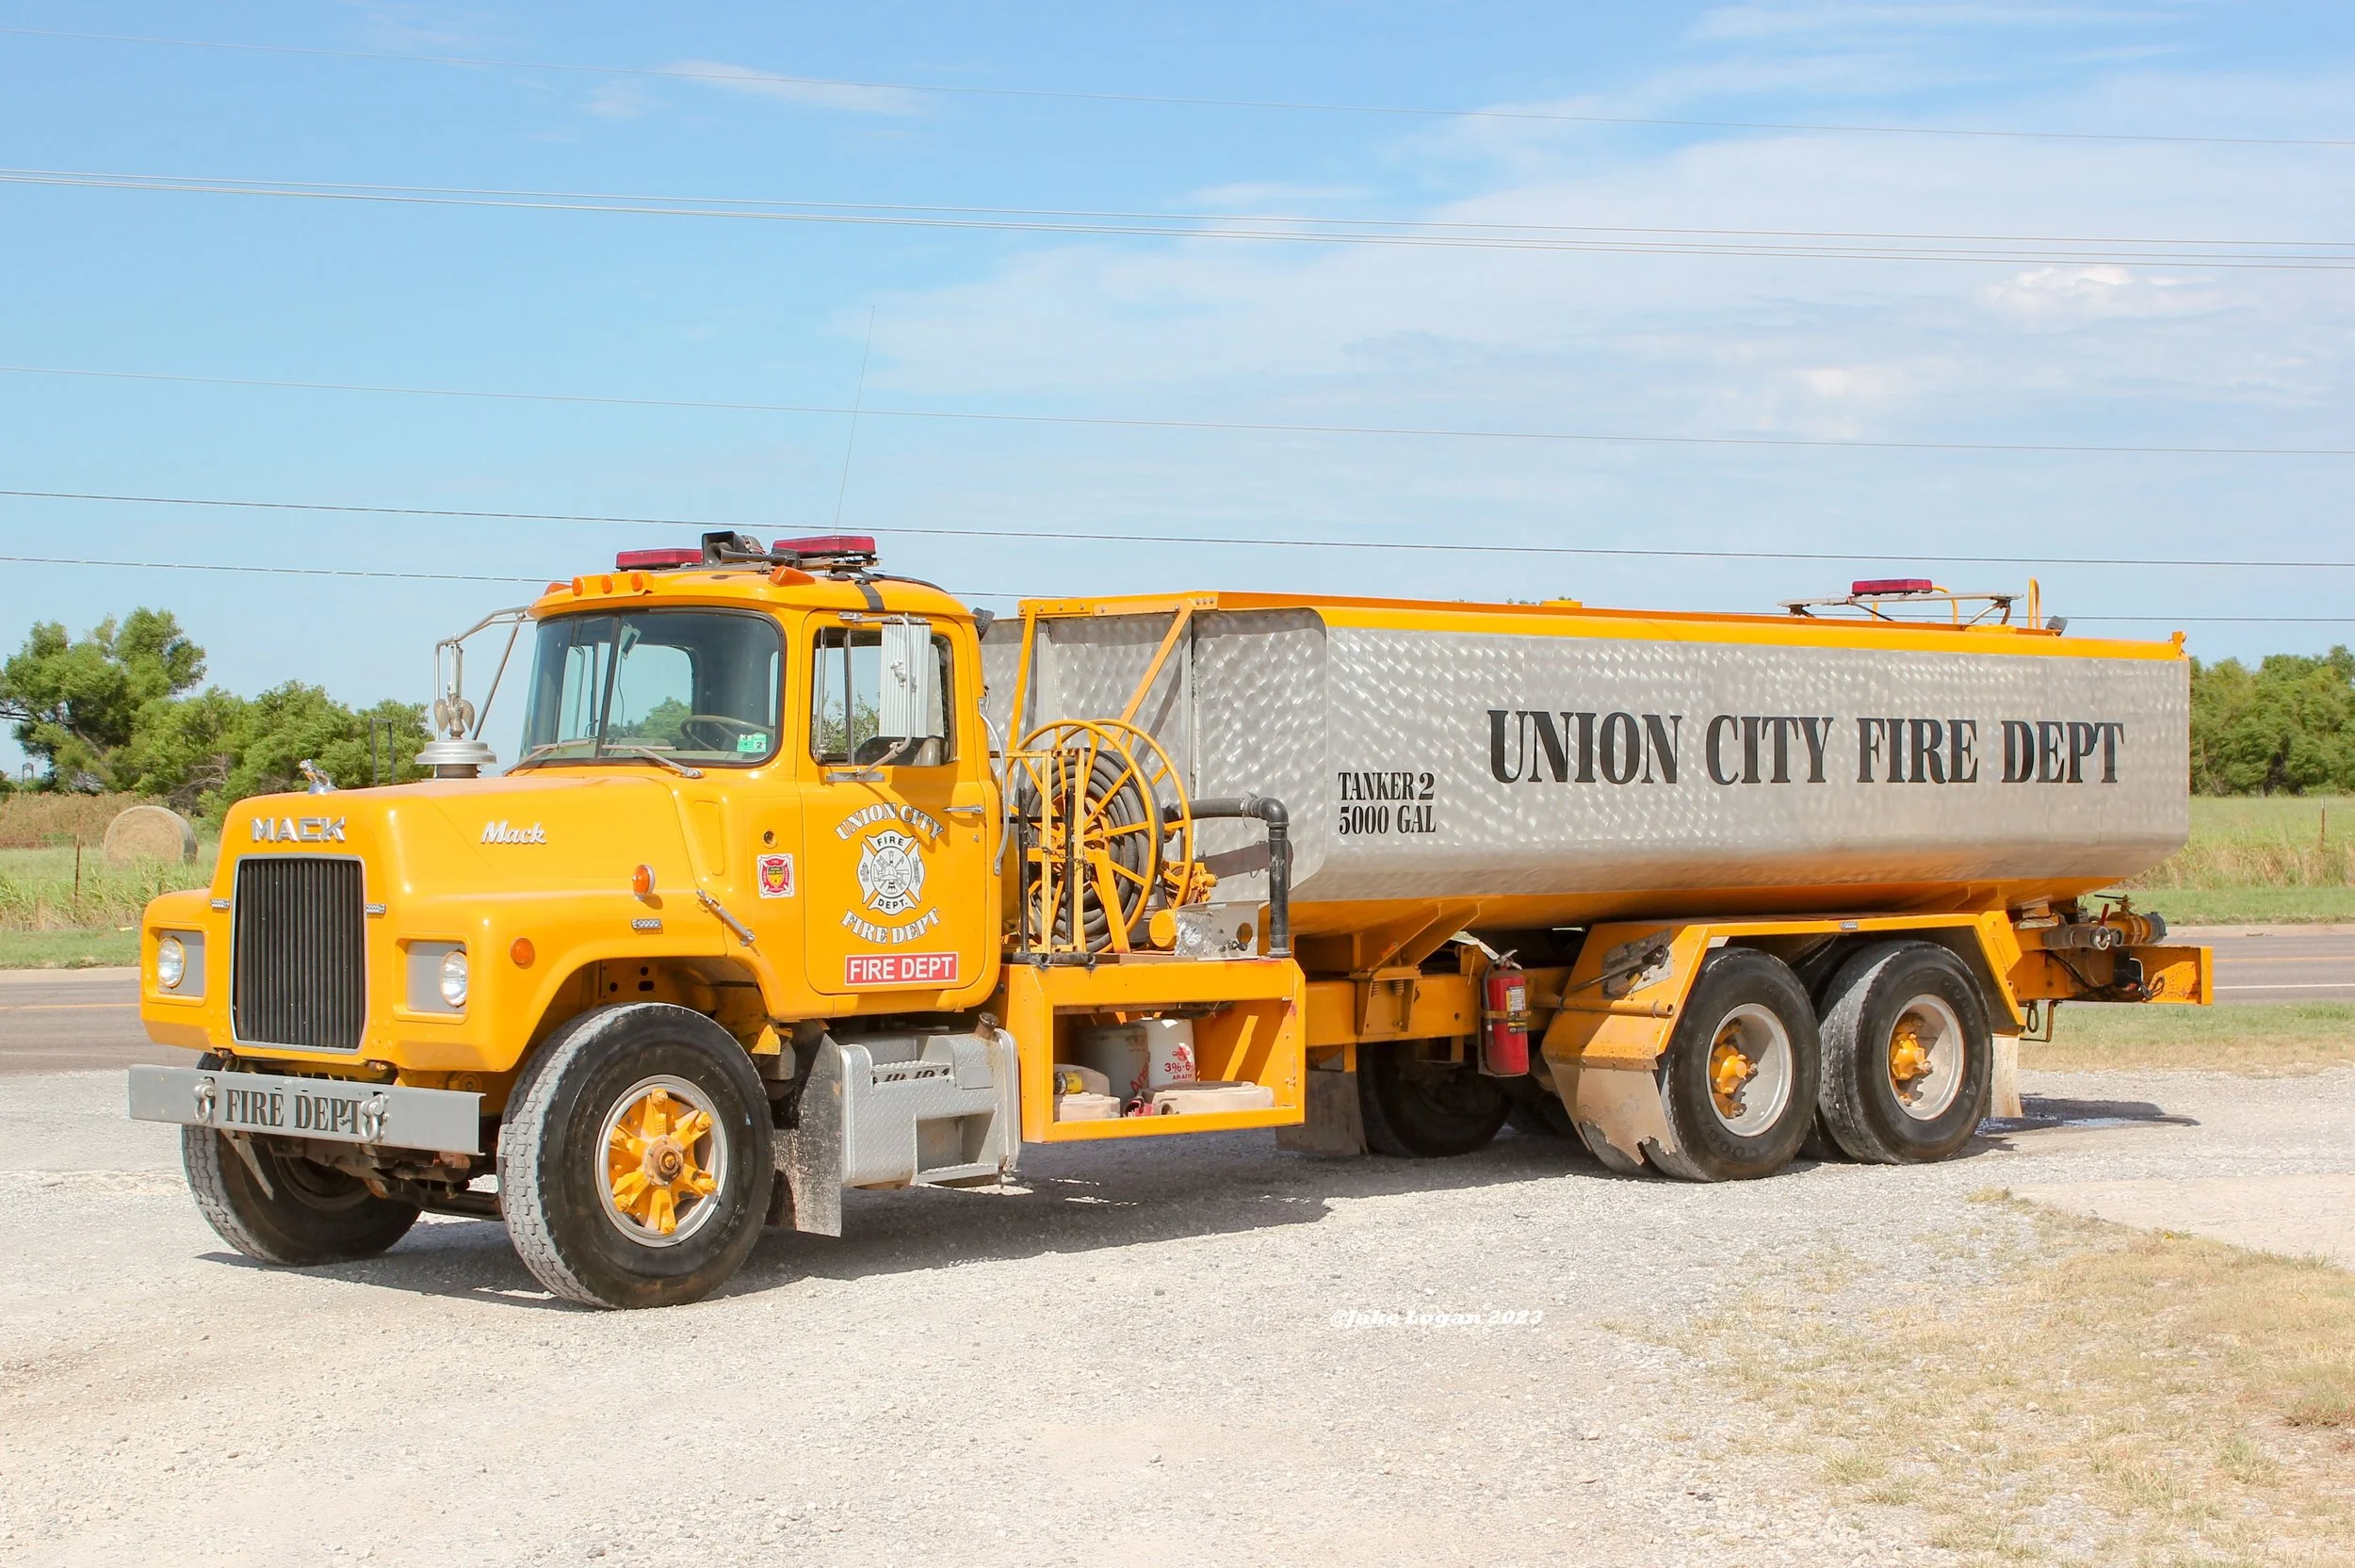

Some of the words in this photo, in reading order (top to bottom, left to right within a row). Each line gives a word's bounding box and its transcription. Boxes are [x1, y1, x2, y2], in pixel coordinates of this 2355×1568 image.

[1486, 709, 1682, 785] UNION
[1705, 715, 1834, 785] CITY
[1856, 718, 1978, 784] FIRE
[2000, 719, 2124, 784] DEPT
[1338, 772, 1414, 800] TANKER
[1418, 772, 1435, 800] 2
[251, 816, 346, 843] MACK
[480, 819, 546, 845] Mack
[835, 802, 897, 840] UNION
[900, 805, 944, 840] CITY
[1339, 805, 1389, 835] 5000
[1396, 804, 1437, 834] GAL
[877, 836, 904, 847] FIRE
[840, 910, 887, 944] FIRE
[891, 907, 940, 944] DEPT
[850, 960, 895, 980] FIRE
[901, 957, 953, 978] DEPT
[225, 1089, 284, 1127] FIRE
[294, 1094, 362, 1135] DEPT
